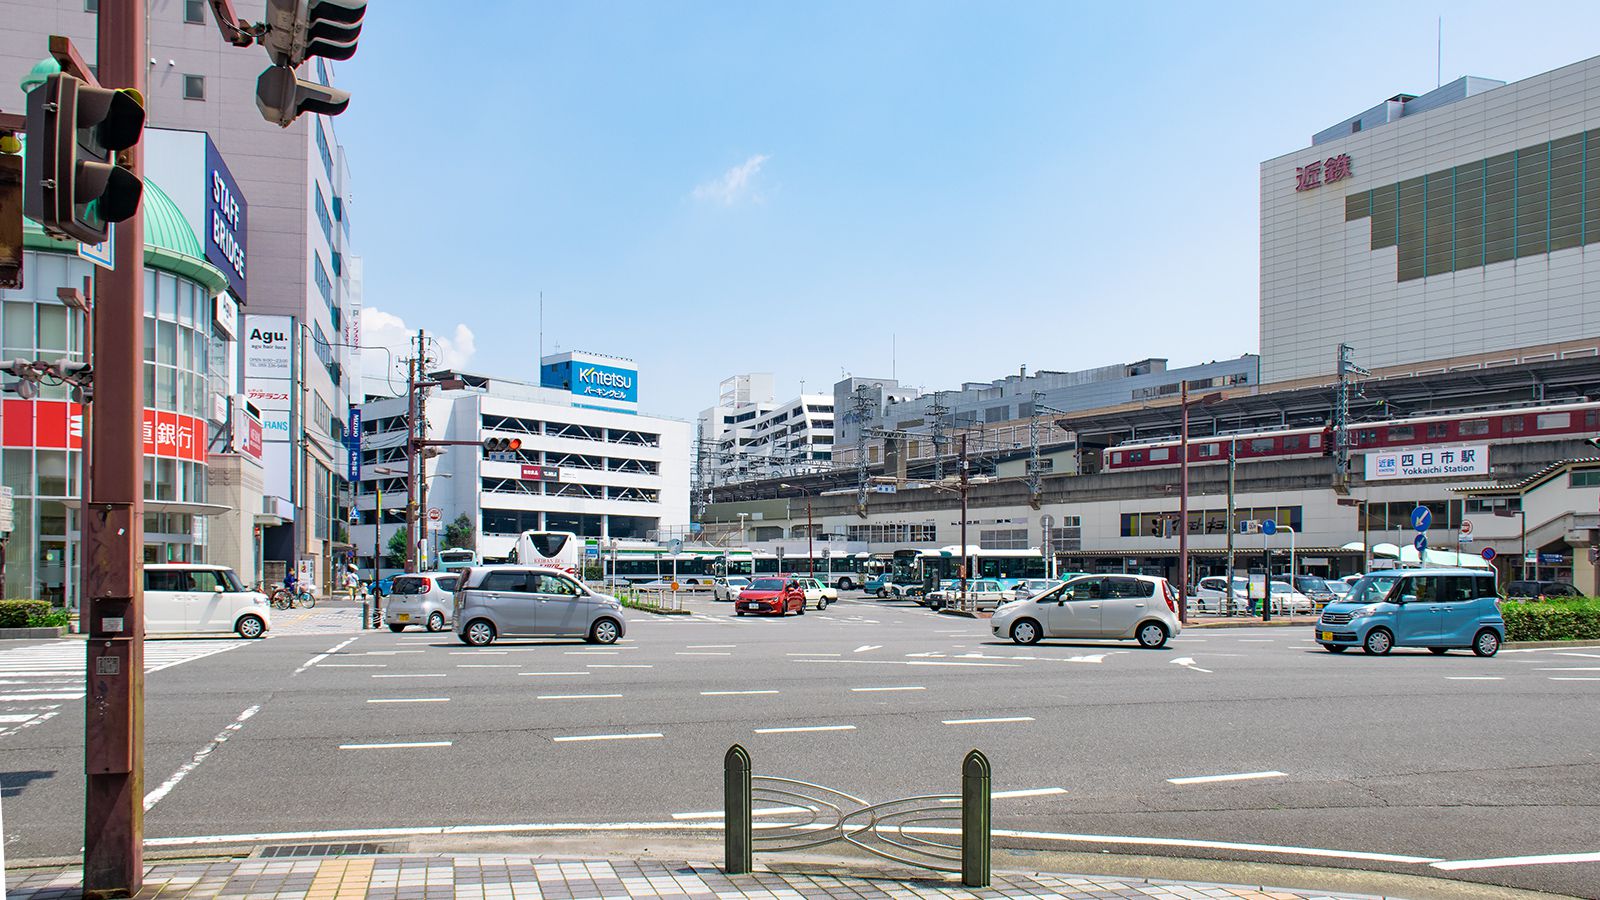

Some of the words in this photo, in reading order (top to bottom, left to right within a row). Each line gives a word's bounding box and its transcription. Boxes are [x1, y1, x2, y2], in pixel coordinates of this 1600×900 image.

[1294, 152, 1353, 193] 近鉄
[212, 169, 240, 231] STAFF
[212, 209, 245, 280] BRIDGE
[250, 328, 288, 344] Agu.
[248, 392, 289, 401] アデランス
[584, 386, 627, 399] パーキングビル
[1378, 458, 1396, 468] 近鉄
[1401, 449, 1475, 467] 四日市駅
[1402, 466, 1442, 476] Yokkaichi
[1443, 464, 1475, 473] Station
